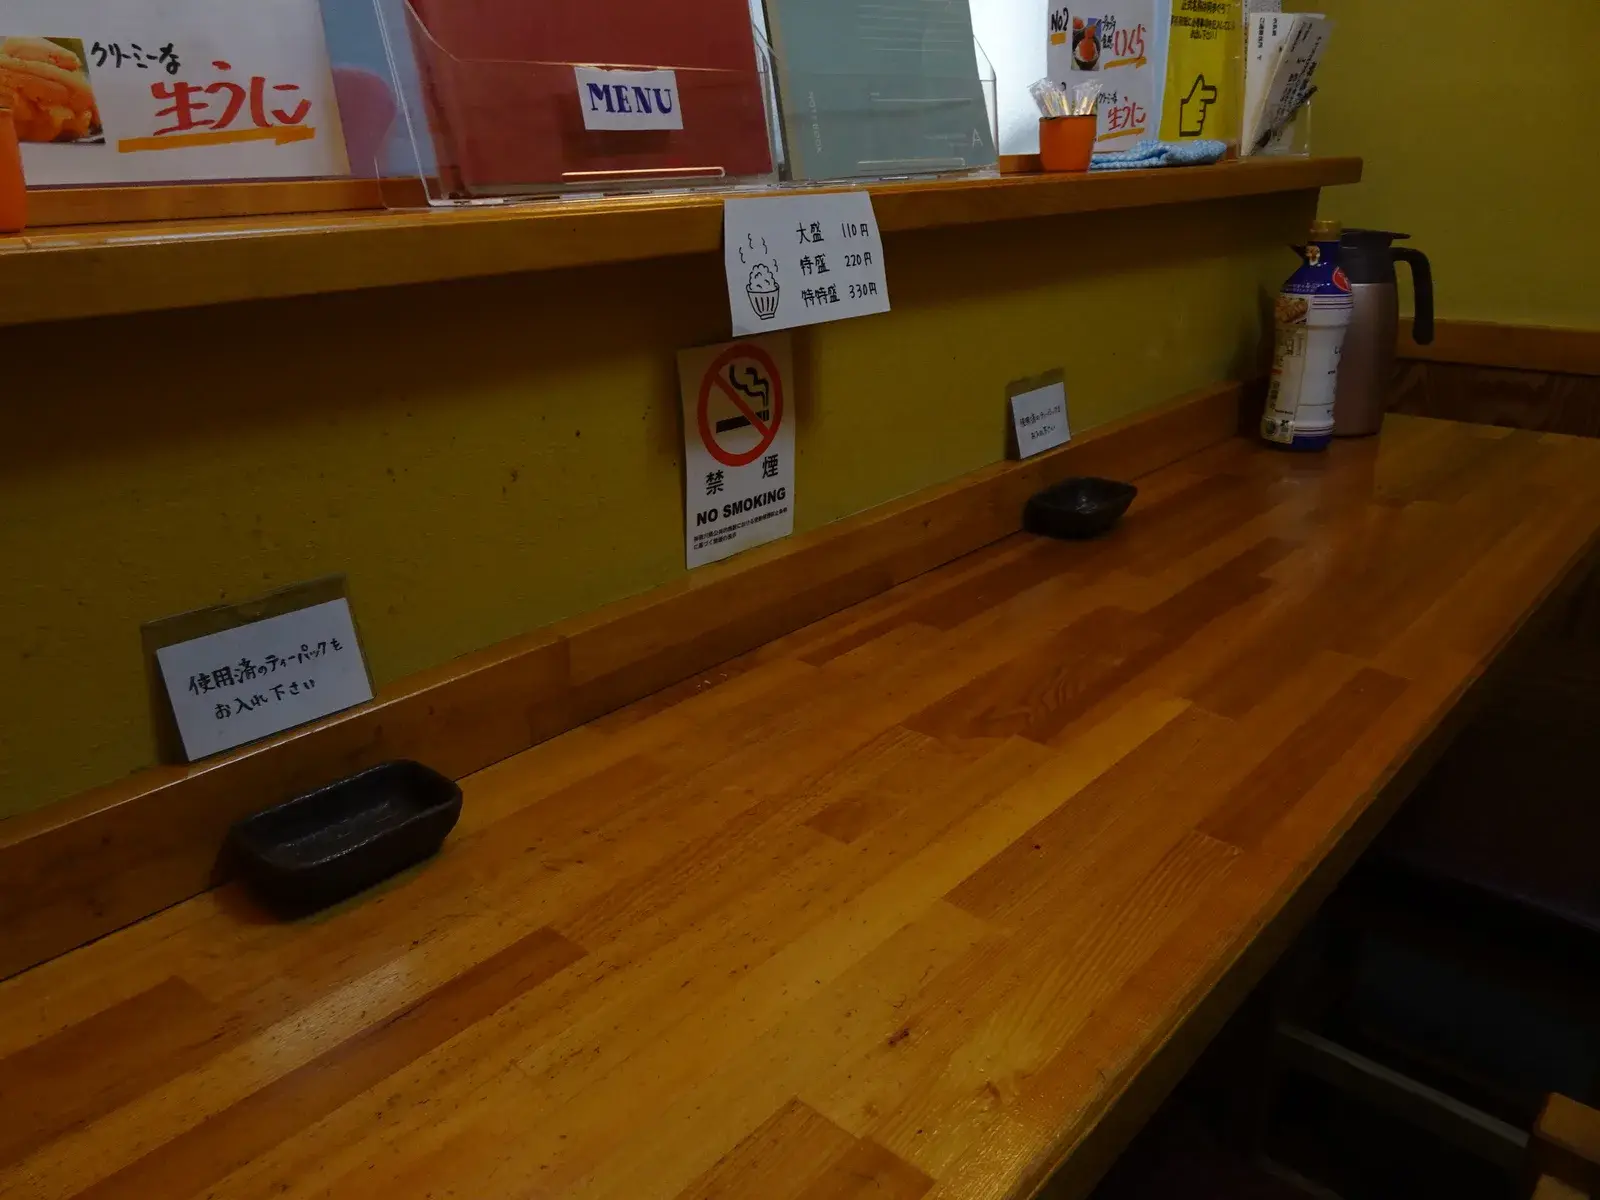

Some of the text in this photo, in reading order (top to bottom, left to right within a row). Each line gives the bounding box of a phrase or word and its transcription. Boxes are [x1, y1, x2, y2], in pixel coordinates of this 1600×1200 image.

[1115, 24, 1146, 58] いくら
[91, 43, 181, 75] クリーミーな
[150, 61, 312, 136] 生うに
[586, 81, 673, 115] MENU
[1108, 96, 1146, 131] 生うに
[972, 128, 984, 149] A
[796, 221, 869, 244] 大盛 110円
[800, 252, 872, 276] 特盛 220円
[801, 282, 878, 308] 特特盛 330円
[696, 487, 787, 527] NO SMOKING
